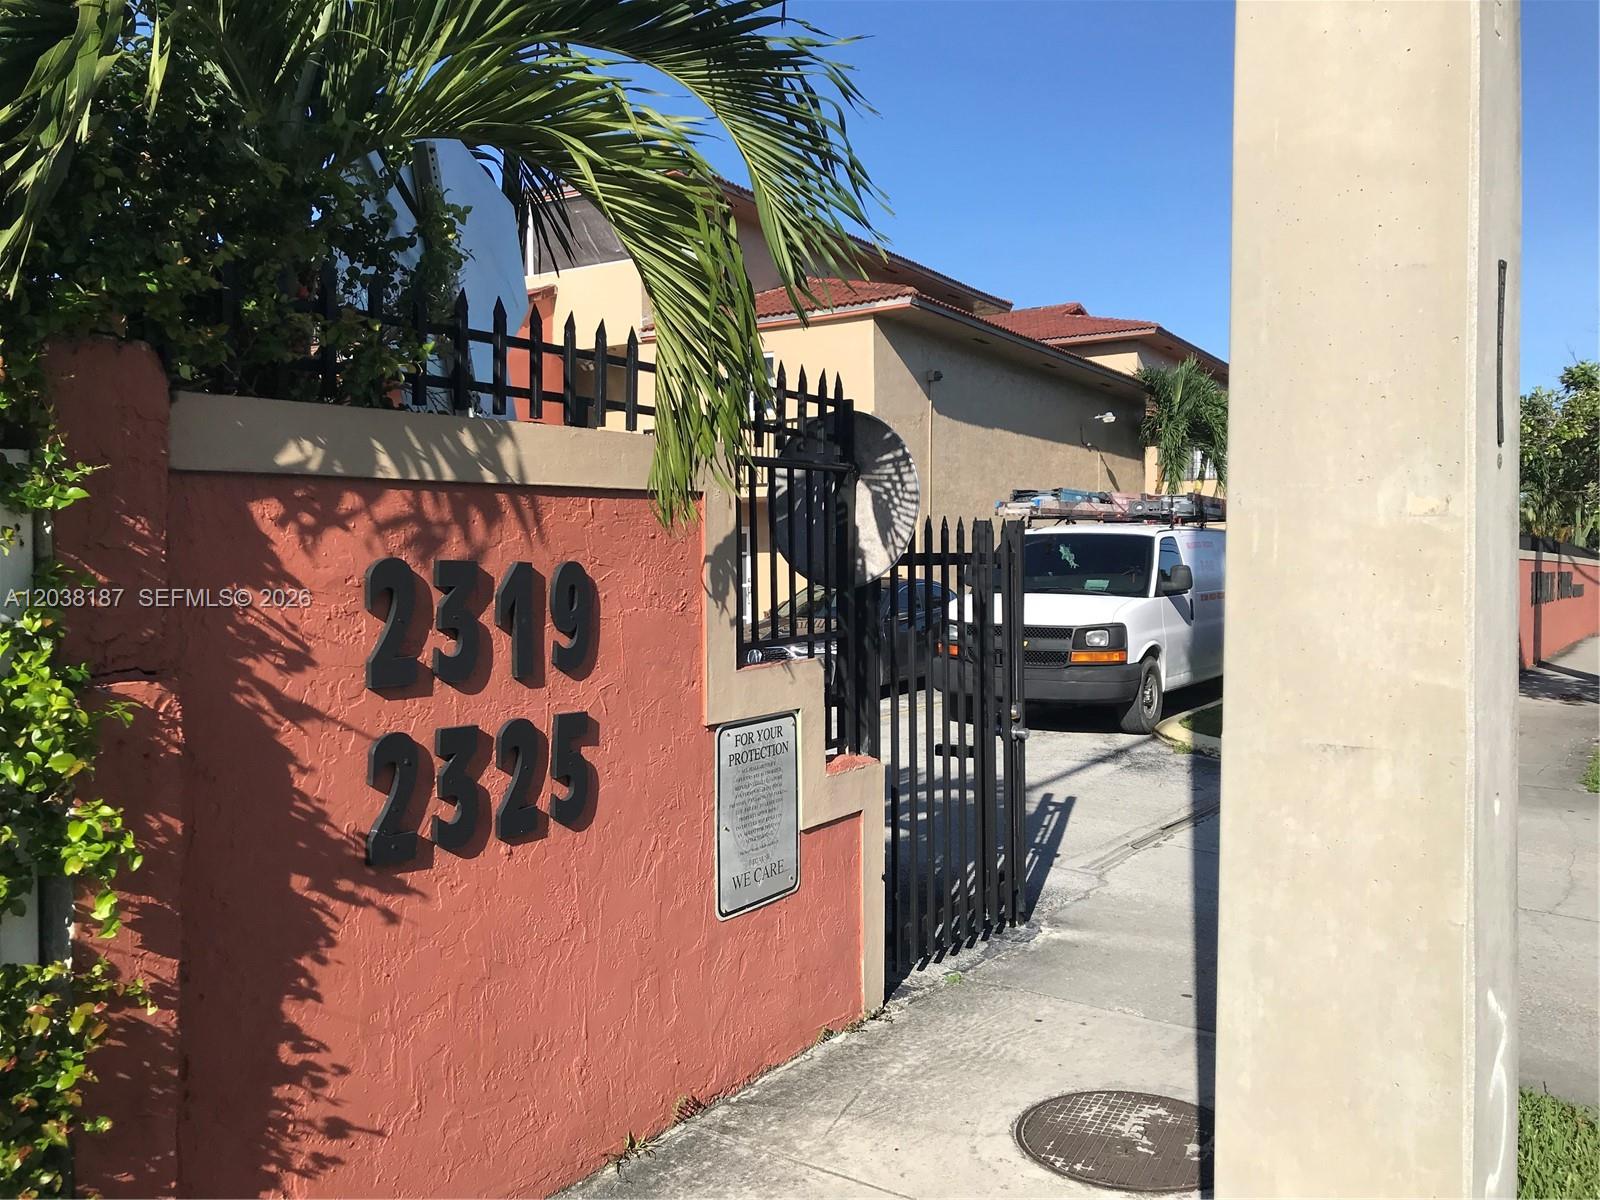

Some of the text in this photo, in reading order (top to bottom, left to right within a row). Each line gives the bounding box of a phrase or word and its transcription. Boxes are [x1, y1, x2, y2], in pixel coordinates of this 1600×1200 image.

[365, 557, 589, 689] 2319
[734, 725, 784, 748] FOR YOUR
[728, 741, 789, 767] PROTECTION
[366, 711, 589, 866] 2325
[732, 871, 752, 890] WE
[753, 859, 785, 883] CARE
